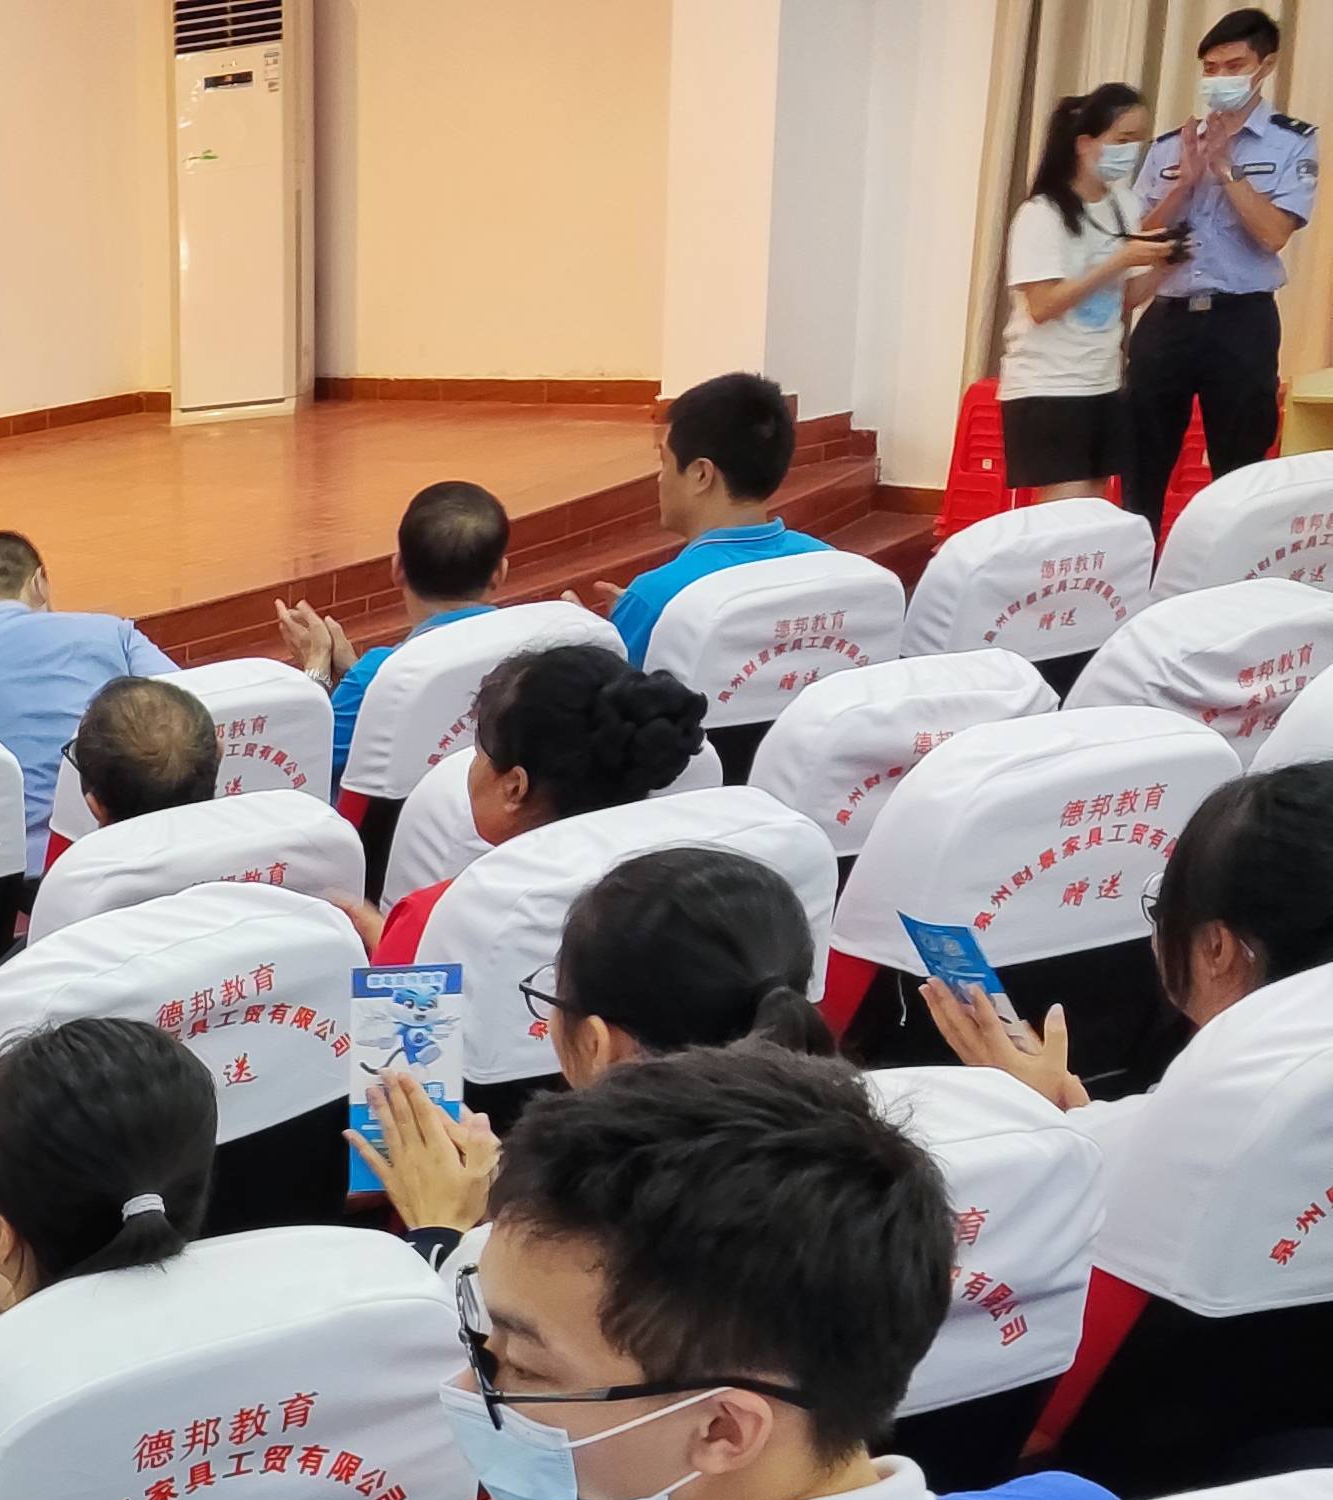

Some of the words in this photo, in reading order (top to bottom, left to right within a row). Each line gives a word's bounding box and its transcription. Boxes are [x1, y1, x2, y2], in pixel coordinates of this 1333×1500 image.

[774, 609, 847, 639] 德邦教育
[1059, 783, 1168, 829] 德邦教育
[1058, 870, 1123, 908] 赠送
[155, 962, 276, 1030] 德邦教育
[132, 1391, 319, 1474] 德邦教育
